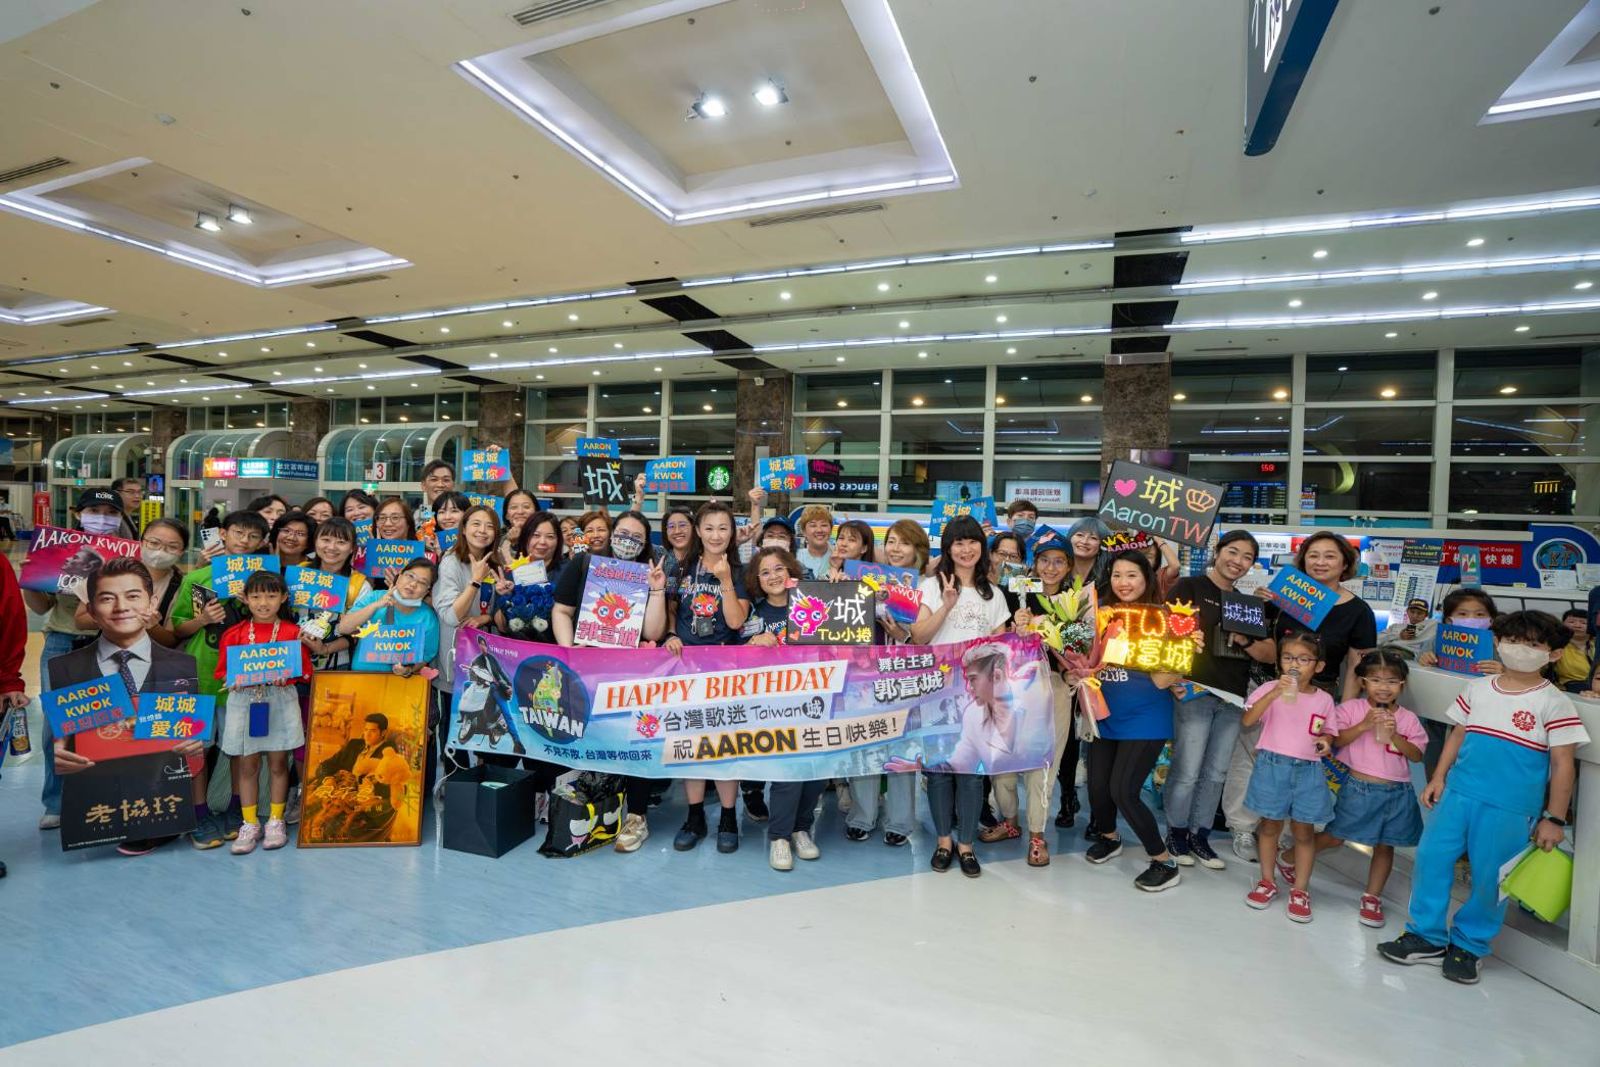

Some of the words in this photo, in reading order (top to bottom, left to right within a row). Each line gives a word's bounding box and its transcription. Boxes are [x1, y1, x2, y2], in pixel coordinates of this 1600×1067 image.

[583, 442, 612, 451] AARON
[375, 464, 384, 480] 3
[652, 461, 687, 470] AARON
[583, 462, 624, 502] 城
[653, 472, 684, 481] KWOK
[1138, 475, 1184, 512] 城
[32, 528, 93, 552] AARON
[96, 536, 141, 557] KWOK
[375, 544, 415, 553] AARON
[1107, 540, 1148, 553] AARON
[226, 557, 264, 573] 城城
[377, 556, 411, 566] KWOK
[297, 570, 335, 589] 城城
[1286, 574, 1326, 601] AARON
[293, 590, 330, 608] 愛你
[1280, 585, 1316, 611] KWOK
[833, 593, 867, 625] 城
[373, 628, 416, 638] AARON
[1442, 630, 1479, 645] AARON
[240, 646, 289, 660] AARON
[375, 642, 412, 651] KWOK
[1441, 644, 1475, 659] KWOK
[243, 659, 286, 672] KWOK
[878, 653, 935, 672] 舞台王者
[1097, 670, 1129, 682] CLUB
[56, 682, 111, 706] AARON
[606, 678, 695, 709] HAPPY
[705, 666, 837, 699] BIRTHDAY
[874, 670, 945, 701] 郭富城
[65, 697, 113, 718] KWOK
[155, 695, 197, 714] 城城
[519, 706, 584, 738] TAIWAN
[663, 704, 748, 730] 台灣歌迷
[150, 720, 194, 738] 愛你
[673, 739, 694, 760] 祝
[695, 728, 799, 761] AARON
